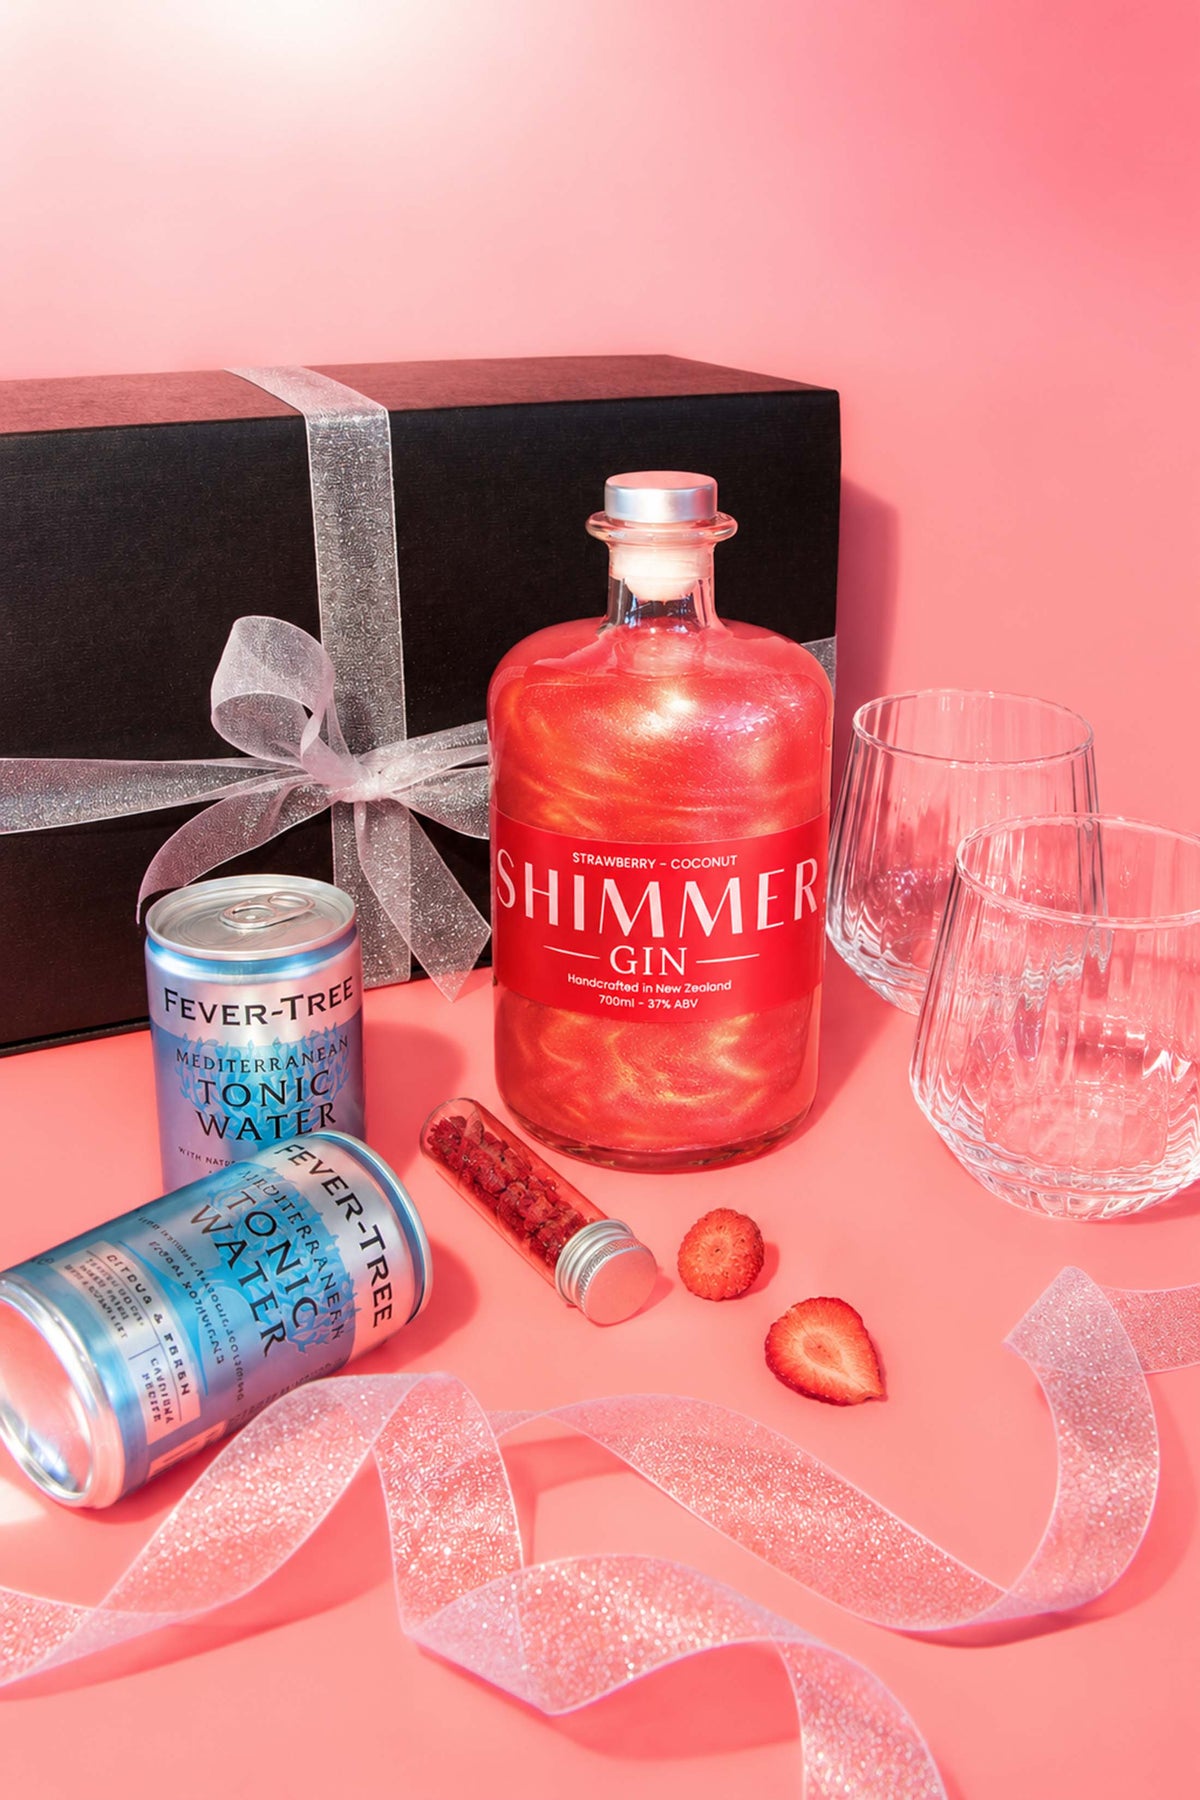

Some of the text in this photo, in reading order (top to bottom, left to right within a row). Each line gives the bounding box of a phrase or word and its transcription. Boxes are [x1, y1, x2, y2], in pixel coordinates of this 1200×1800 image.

[572, 852, 656, 870] STRAWBERRY
[671, 855, 738, 870] COCONUT
[496, 848, 818, 939] SHIMMER
[609, 945, 688, 976] GIN
[164, 976, 354, 1026] FEVER-TREE
[567, 973, 732, 994] Handcrafted in New Zealand
[599, 994, 635, 1009] 700ml
[647, 998, 672, 1010] 37%
[674, 998, 699, 1010] ABV
[176, 1035, 349, 1074] MEDITERRANEAN
[198, 1069, 331, 1108] TONIC
[196, 1102, 337, 1142] WATER
[178, 1146, 202, 1161] WITH
[274, 1144, 393, 1328] FEVER-TREE
[226, 1190, 319, 1328] TONIC
[190, 1204, 287, 1357] WATER
